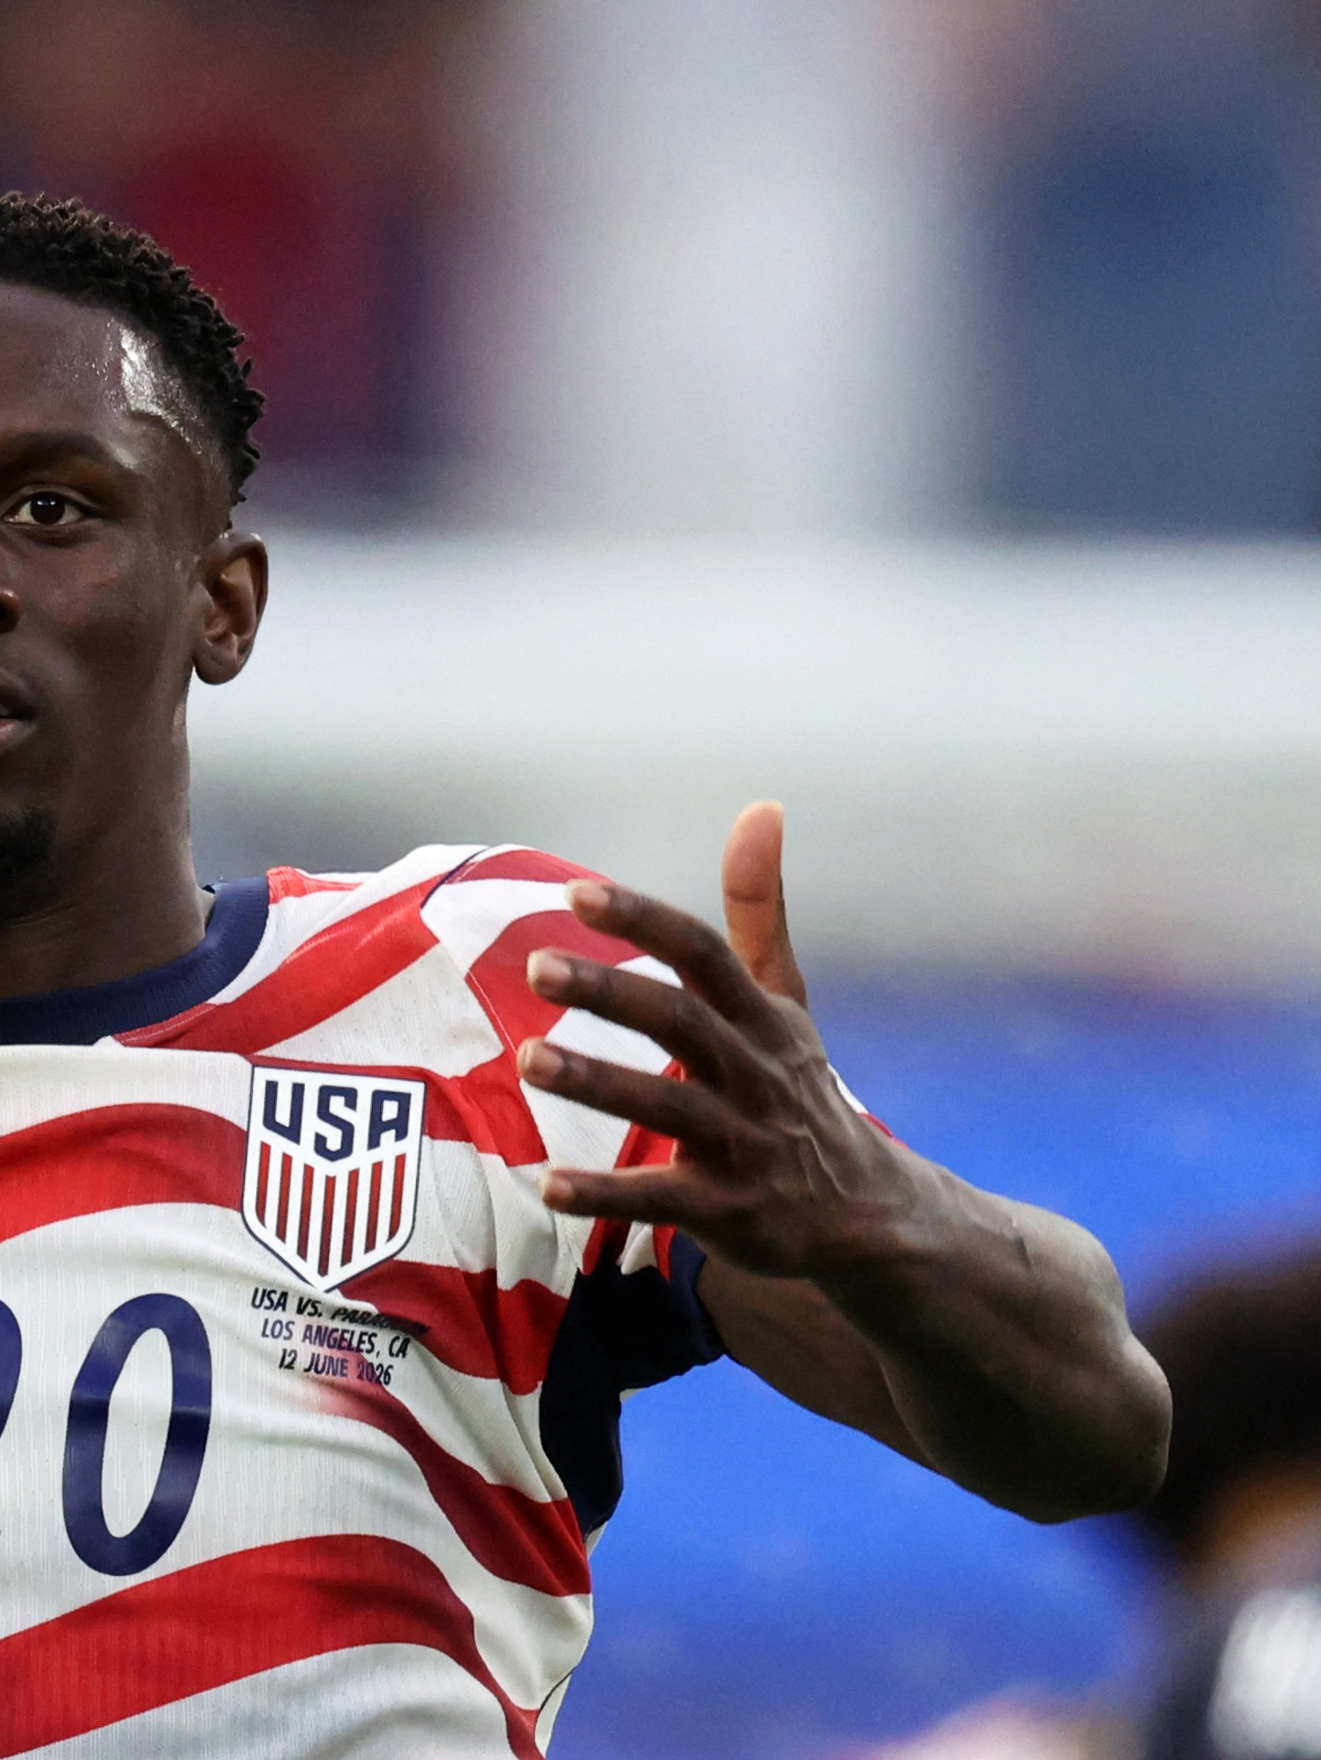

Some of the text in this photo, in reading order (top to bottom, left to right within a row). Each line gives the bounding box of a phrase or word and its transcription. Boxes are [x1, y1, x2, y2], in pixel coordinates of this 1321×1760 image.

[262, 1080, 412, 1162] USA
[250, 1287, 289, 1312] USA
[296, 1296, 323, 1318] VS.
[261, 1318, 411, 1359] LOS ANGELES, CA
[278, 1347, 394, 1386] 12 JUNE 2026
